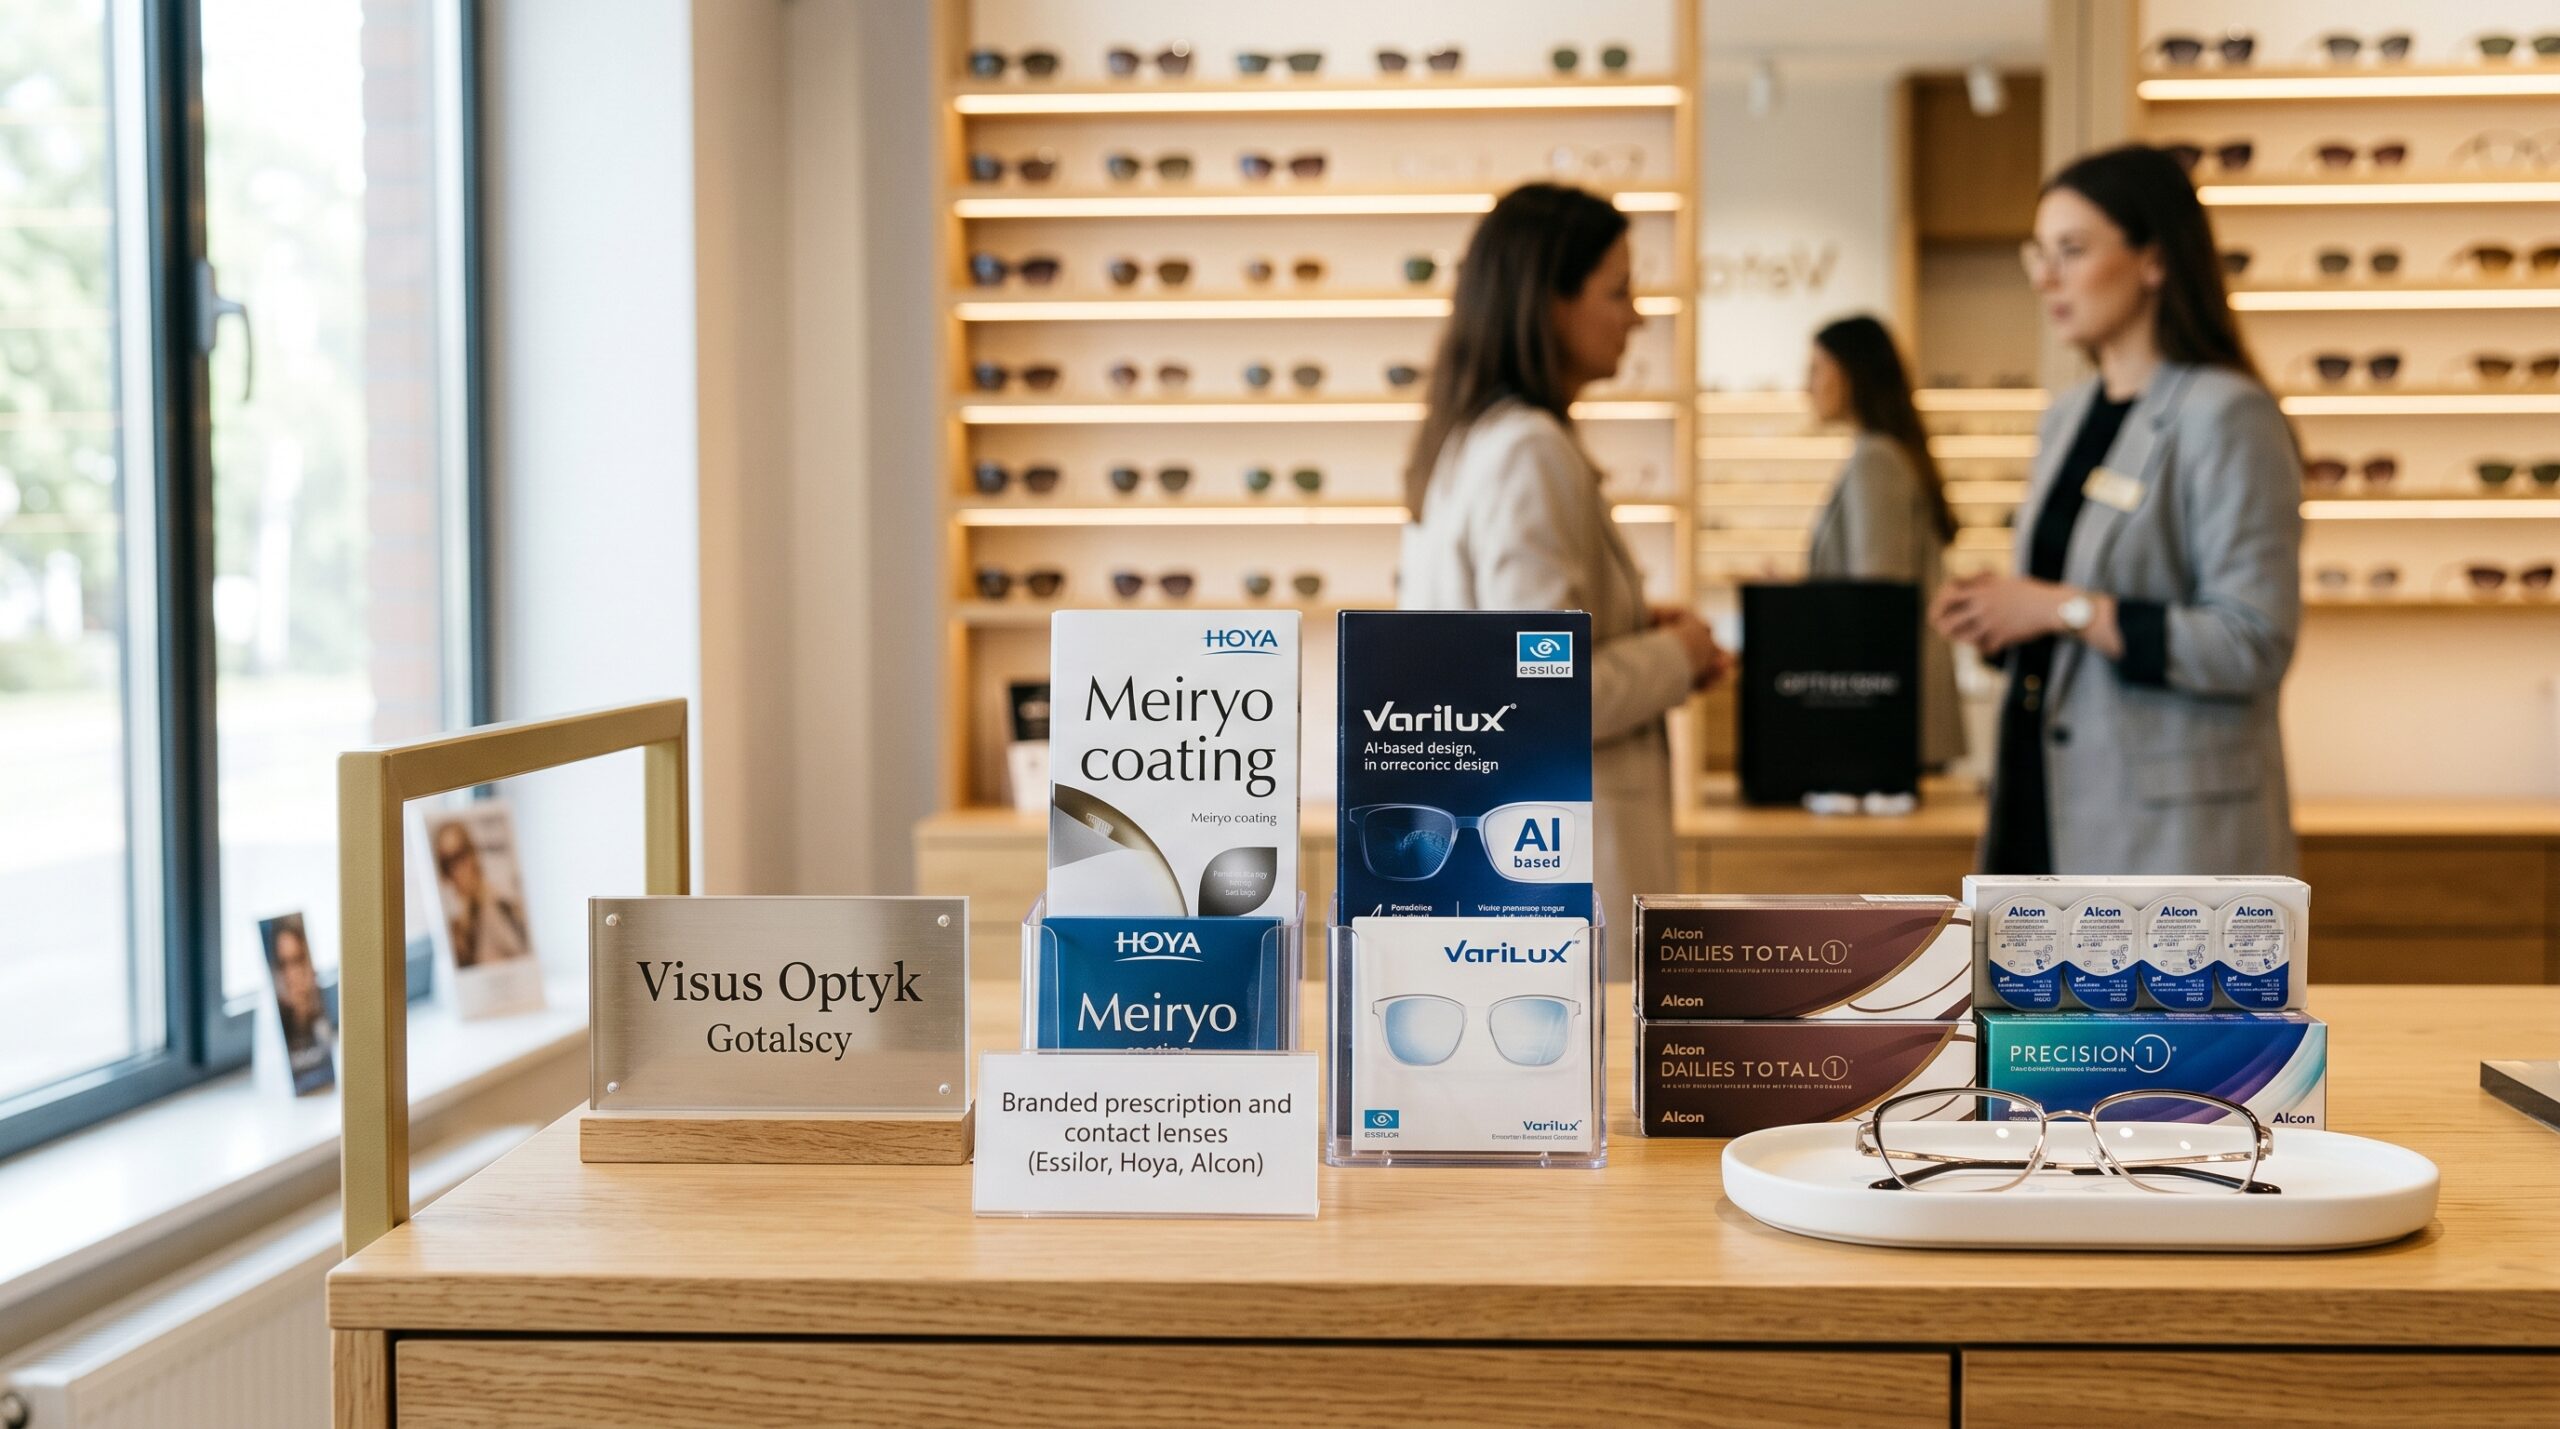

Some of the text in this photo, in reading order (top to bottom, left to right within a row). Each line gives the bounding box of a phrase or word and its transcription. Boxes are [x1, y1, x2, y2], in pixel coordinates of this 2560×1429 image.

[1202, 629, 1278, 648] HOYA
[1519, 664, 1570, 675] essilor
[1085, 675, 1274, 737] Meiryo
[1362, 701, 1511, 732] Varilux
[1364, 741, 1476, 757] AI-based design,
[1081, 735, 1276, 797] coating
[1364, 758, 1377, 771] in
[1454, 758, 1499, 774] design
[1191, 813, 1277, 826] Meiryo coating
[1513, 817, 1560, 852] AI
[1514, 855, 1560, 869] based
[2008, 906, 2045, 917] Alcon
[2084, 906, 2121, 917] Alcon
[2160, 906, 2198, 917] Alcon
[2236, 906, 2273, 917] Alcon
[1661, 927, 1703, 940] Alcon
[1114, 931, 1201, 954] HOYA
[1661, 945, 1734, 962] DAILIES
[636, 960, 923, 1013] Visus Optyk
[1661, 994, 1704, 1007] Alcon
[1078, 991, 1238, 1043] Meiryo
[706, 1022, 853, 1061] Gotalscy
[1662, 1043, 1705, 1056] Alcon
[2010, 1045, 2135, 1063] PRECISION
[1662, 1061, 1735, 1078] DAILIES
[1002, 1092, 1292, 1118] Branded prescription and
[1523, 1119, 1580, 1131] Varilux
[1661, 1111, 1705, 1123] Alcon
[2272, 1111, 2315, 1125] Alcon
[1064, 1122, 1228, 1143] contact lenses
[1028, 1150, 1264, 1178] (Essilor, Hoya, Alcon)
